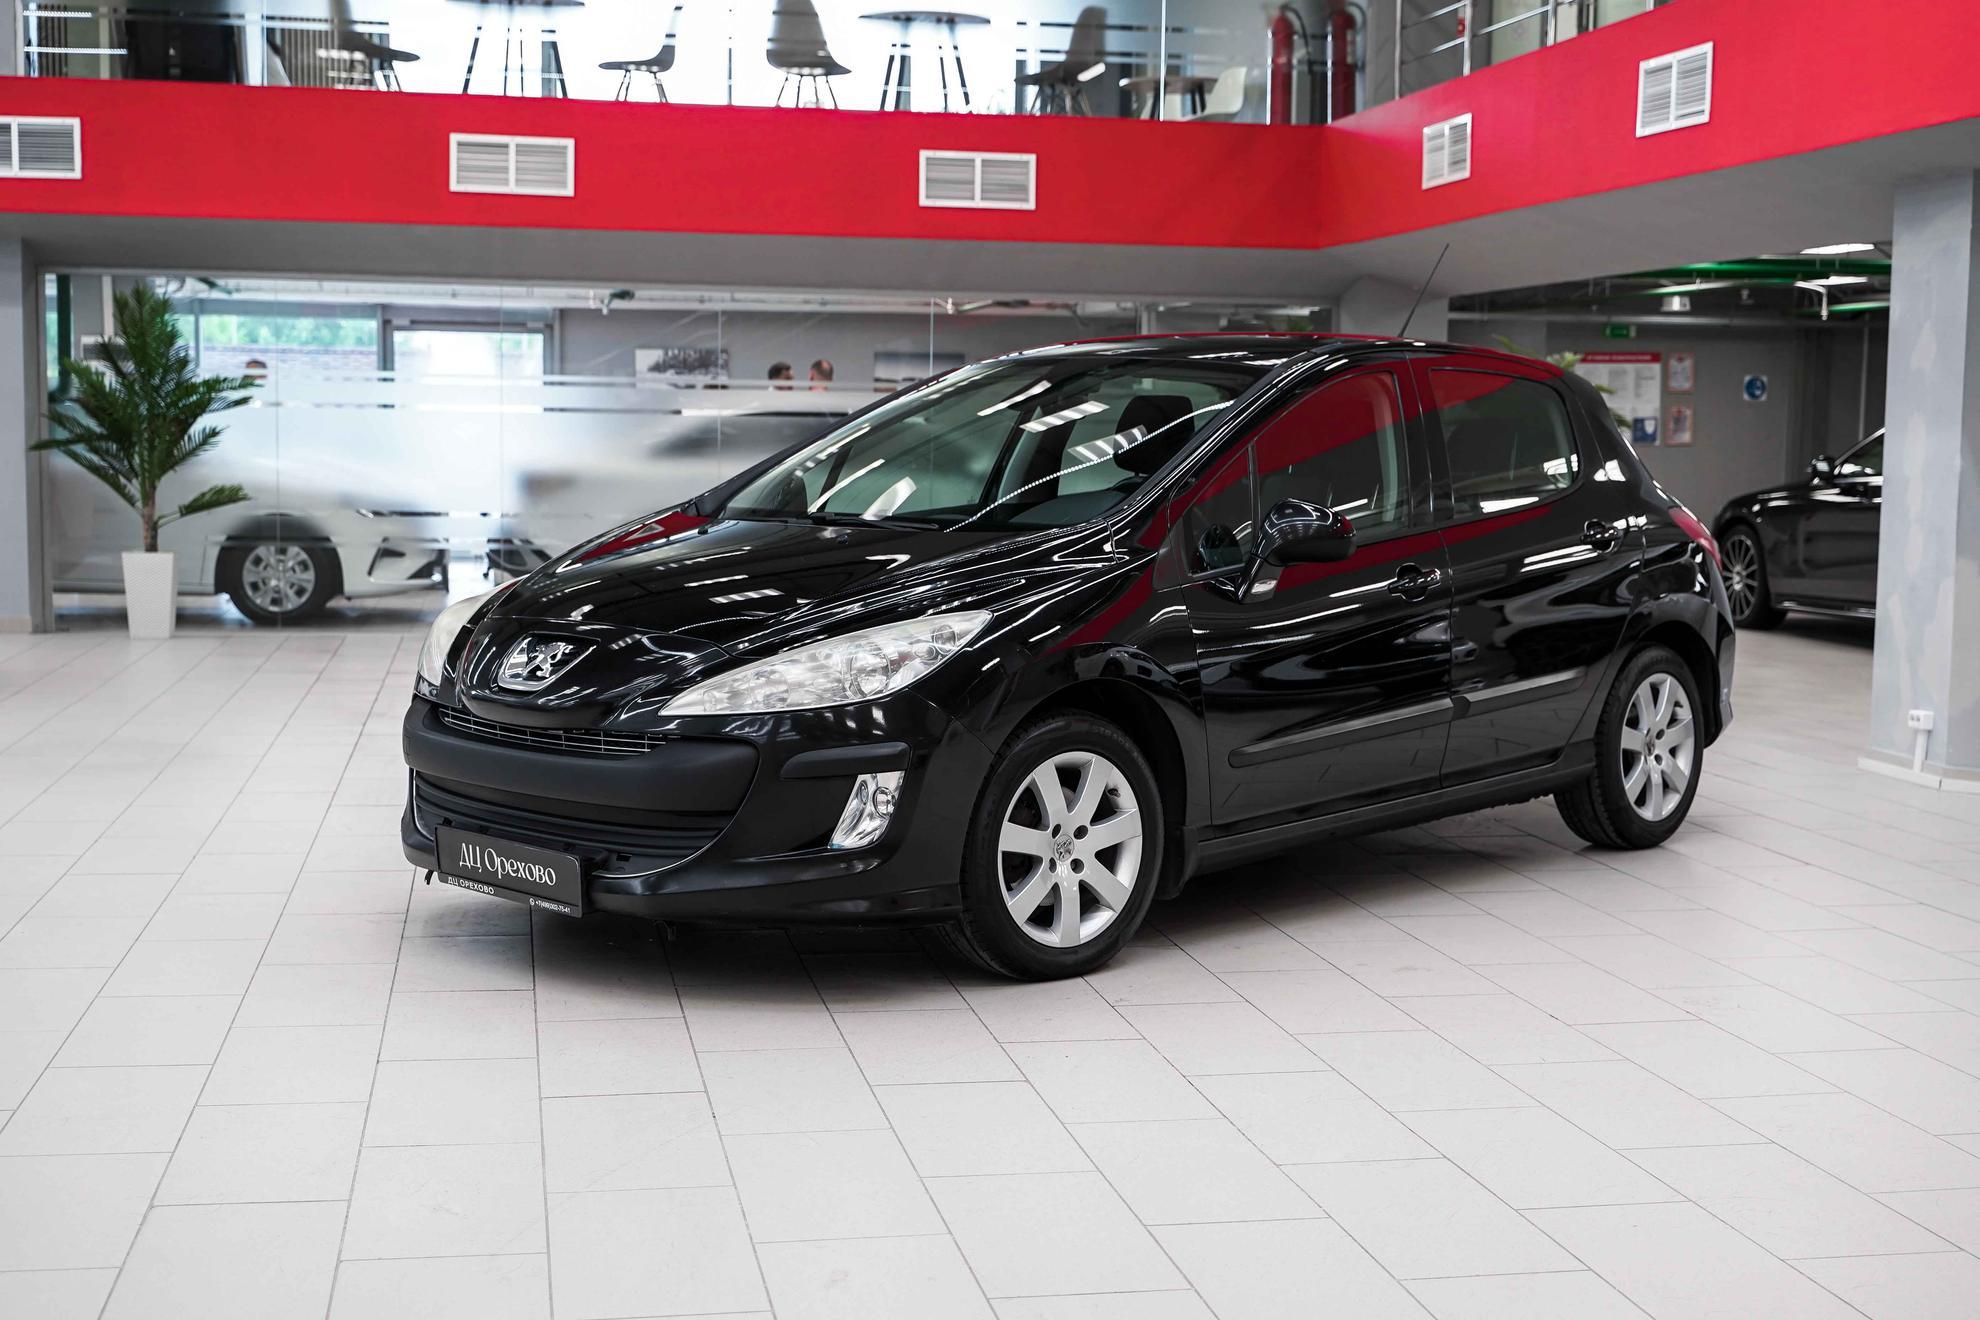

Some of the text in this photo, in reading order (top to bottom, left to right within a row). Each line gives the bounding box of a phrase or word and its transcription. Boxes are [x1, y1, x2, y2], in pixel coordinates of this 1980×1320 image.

[460, 842, 556, 886] ДЦ Орехово
[448, 876, 494, 894] ДЦ ОРЕХОВО
